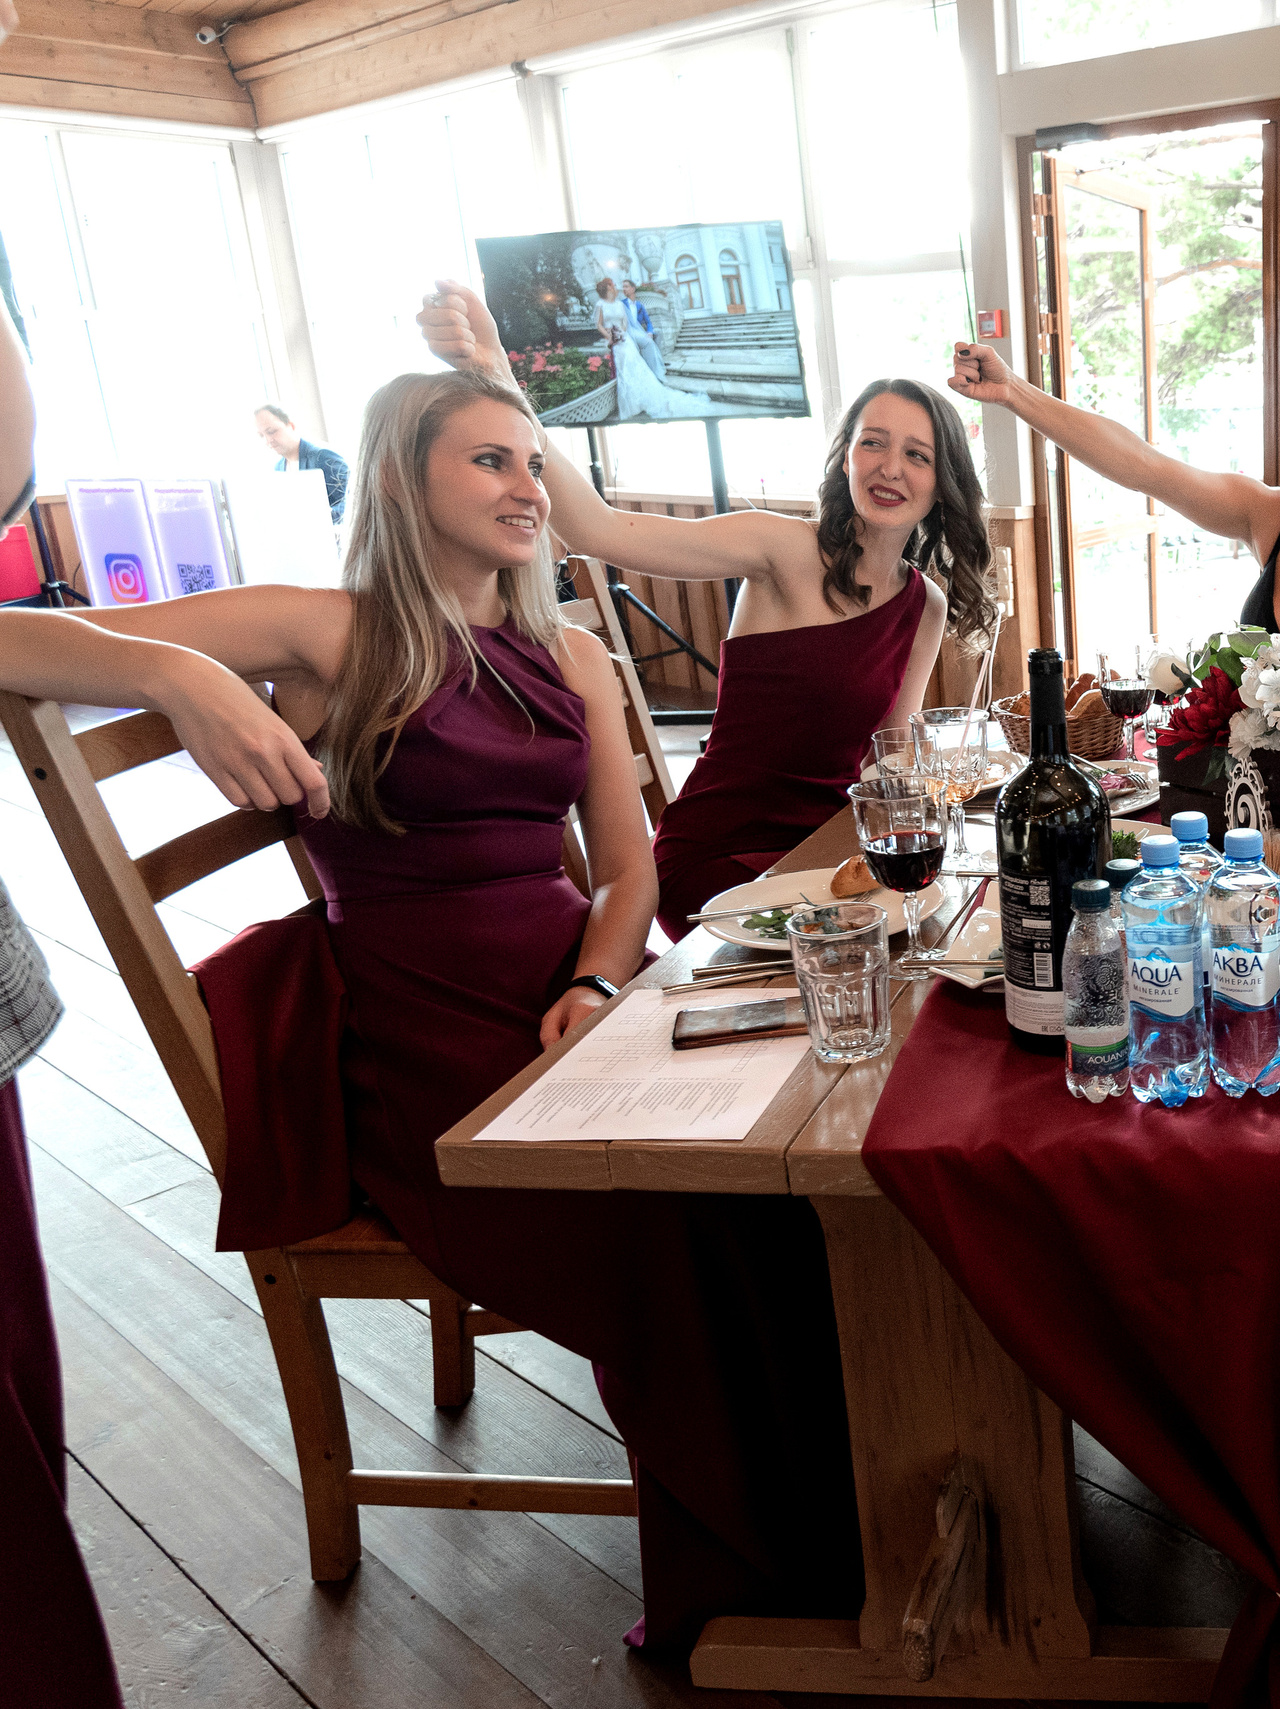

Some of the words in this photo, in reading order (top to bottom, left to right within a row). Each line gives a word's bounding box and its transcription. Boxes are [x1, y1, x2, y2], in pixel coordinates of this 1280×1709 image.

[1131, 961, 1182, 987] AQUA
[1213, 951, 1263, 977] АКВА
[1133, 984, 1179, 995] MINERALE
